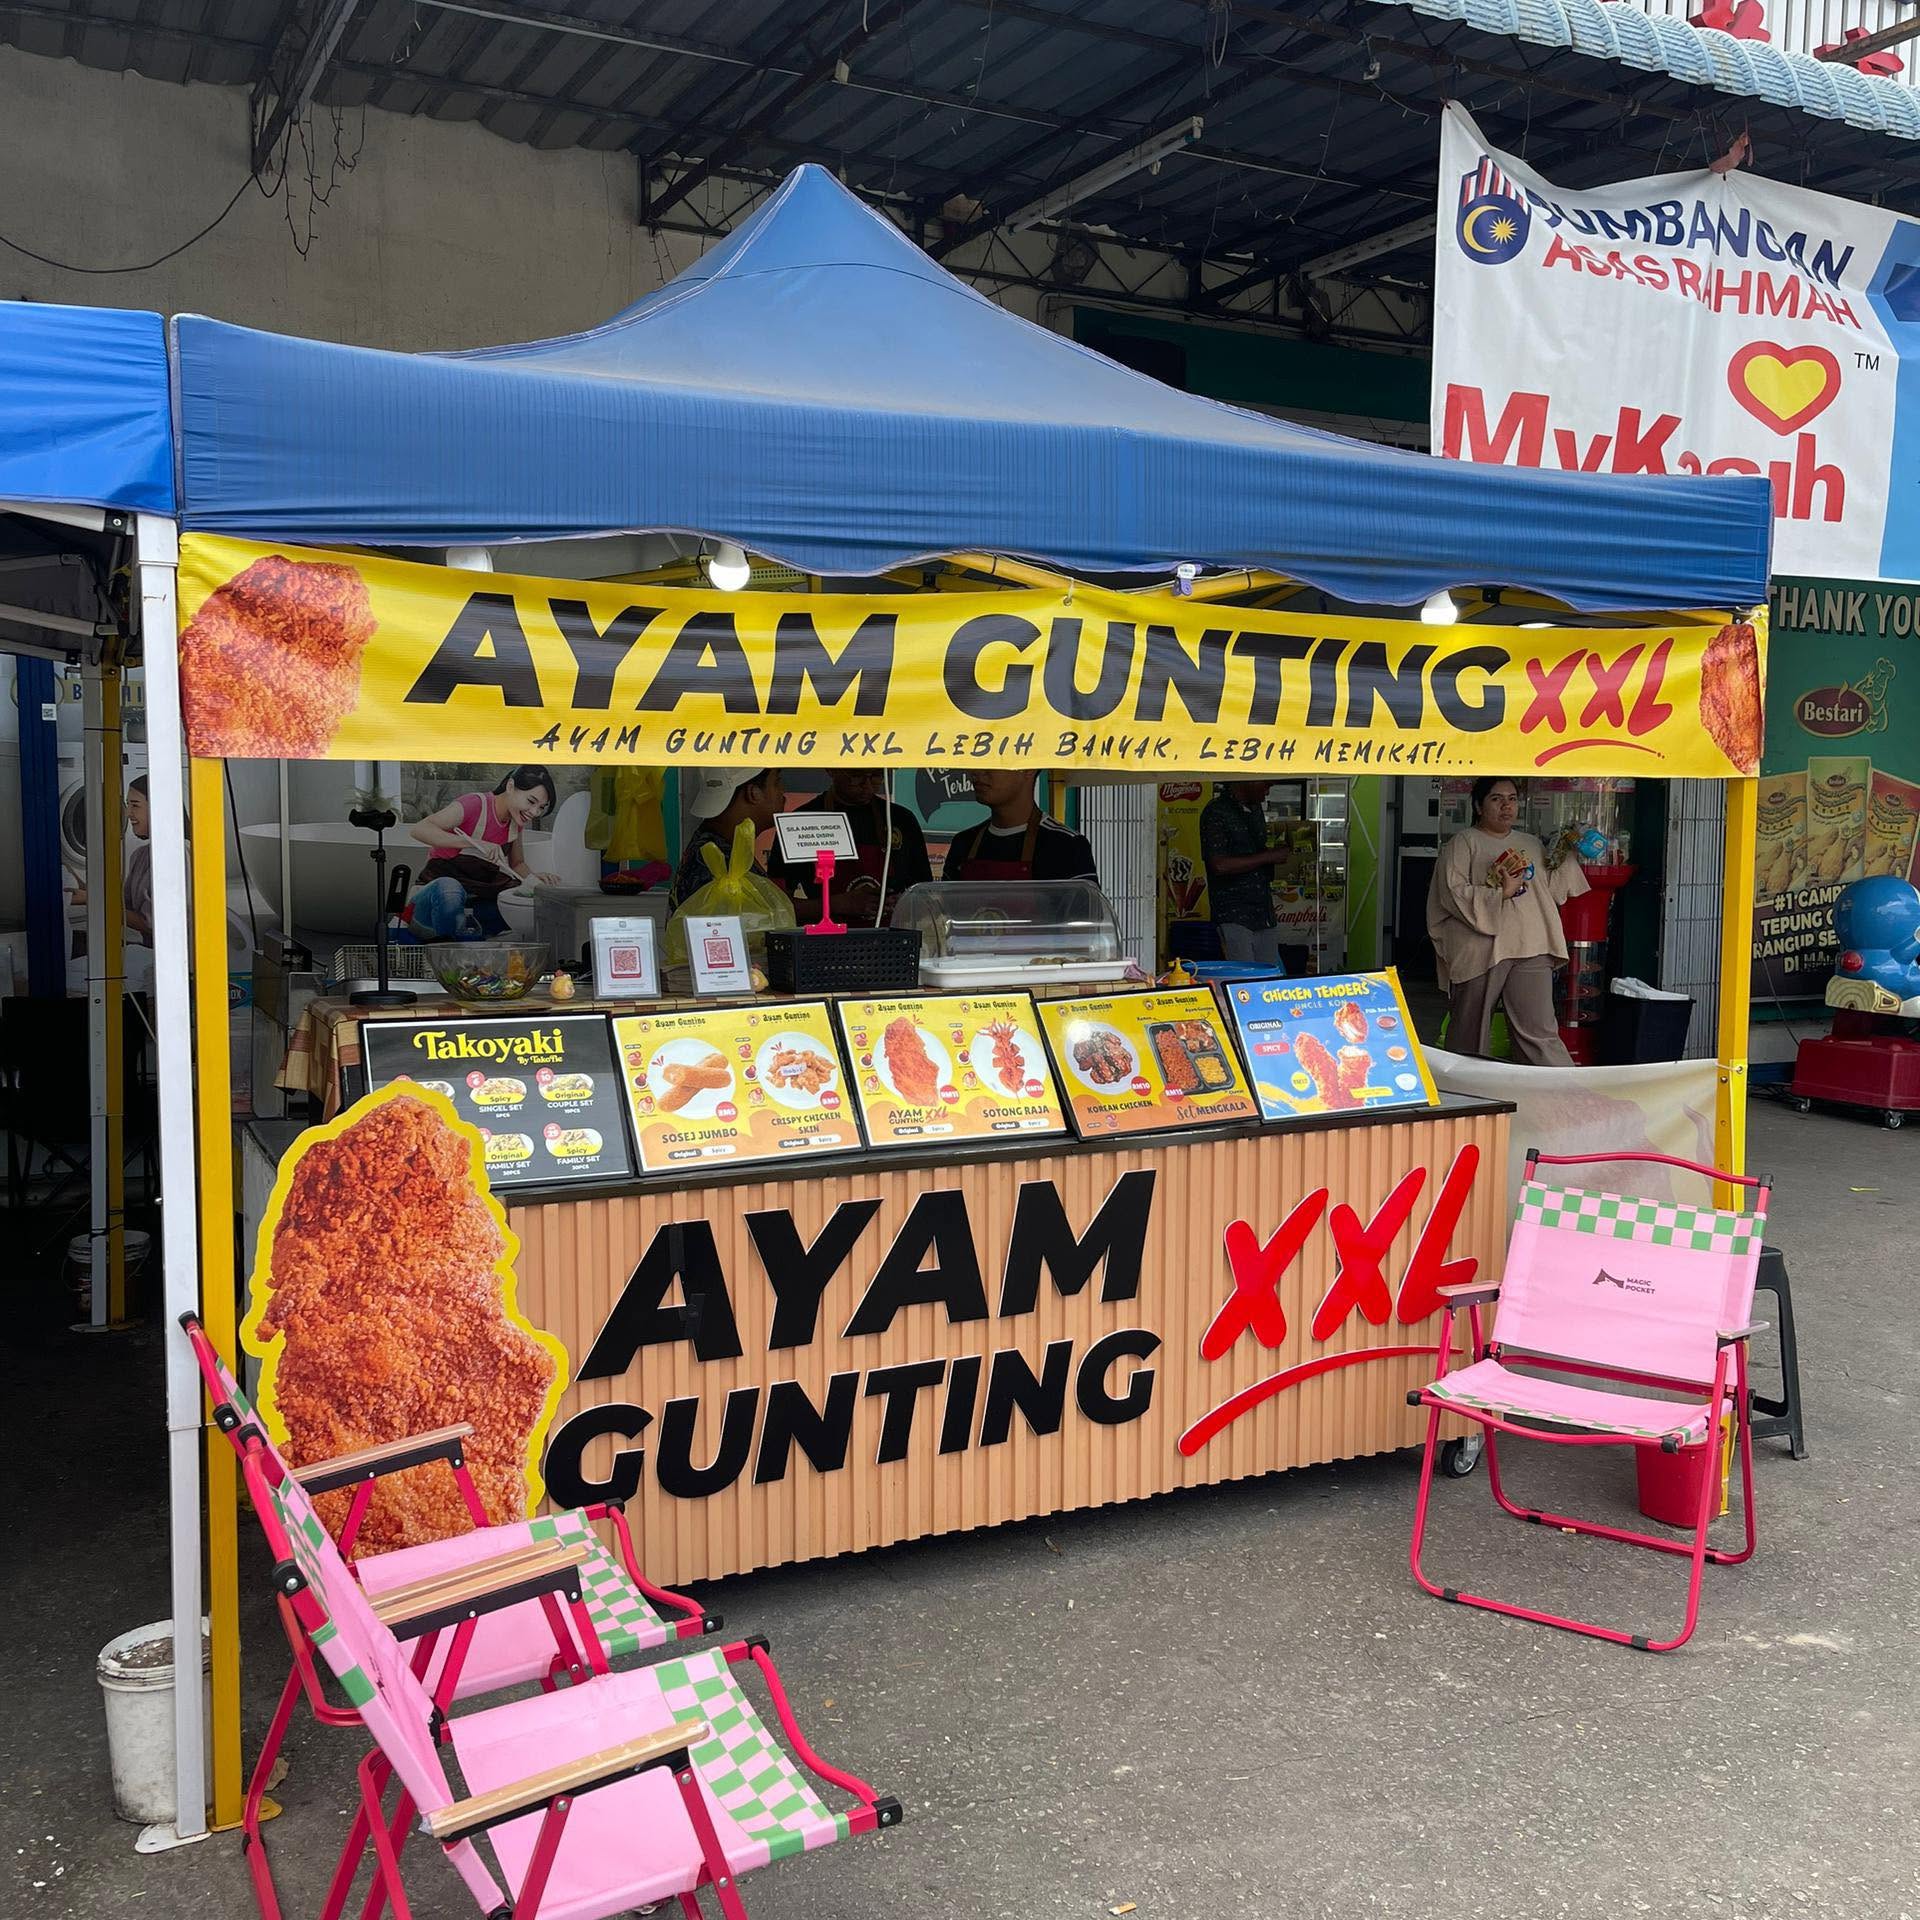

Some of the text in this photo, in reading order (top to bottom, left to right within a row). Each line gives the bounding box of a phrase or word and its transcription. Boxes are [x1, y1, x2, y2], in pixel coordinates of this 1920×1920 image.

[1543, 233, 1862, 329] ASAS RAHMAH
[1854, 353, 1880, 371] TM
[404, 591, 1673, 737] AYAM GUNTING XXL
[1803, 700, 1863, 724] Bestari
[533, 721, 641, 755] AYAM
[665, 726, 816, 757] GUNTING
[840, 730, 903, 757] XXL
[926, 731, 1034, 759] LEBIH
[1056, 732, 1179, 761] BANYAK,
[1199, 738, 1297, 762] LEBIH
[1773, 892, 1794, 913] #1
[1760, 910, 1823, 937] TEPUNG
[1784, 955, 1799, 974] DI
[1314, 982, 1370, 998] TENDERS
[1294, 1000, 1323, 1010] UNCLE
[1249, 1021, 1283, 1030] ORIGINAL
[413, 1028, 565, 1063] Takoyaki
[517, 1056, 529, 1065] By
[555, 1091, 585, 1099] Original
[547, 1101, 579, 1109] COUPLE
[983, 1105, 1050, 1118] SOTONG RAJA
[1087, 1100, 1153, 1114] KOREAN CHICKEN
[1176, 1102, 1247, 1121] Set MENGKALA
[771, 1111, 841, 1126] CRISPY CHICKEN
[888, 1106, 948, 1121] AYAM XXL
[889, 1117, 925, 1125] GUNTING
[661, 1127, 738, 1144] SOSEJ JUMBO
[798, 1125, 820, 1134] SKIN
[491, 1152, 523, 1160] Original
[556, 1154, 601, 1166] FAMILY SET
[486, 1160, 532, 1170] FAMILY SET
[574, 1143, 1479, 1382] AYAM XXL
[1626, 1277, 1652, 1287] MAGIC
[1625, 1285, 1656, 1295] POCKET
[544, 1327, 1162, 1508] GUNTING
